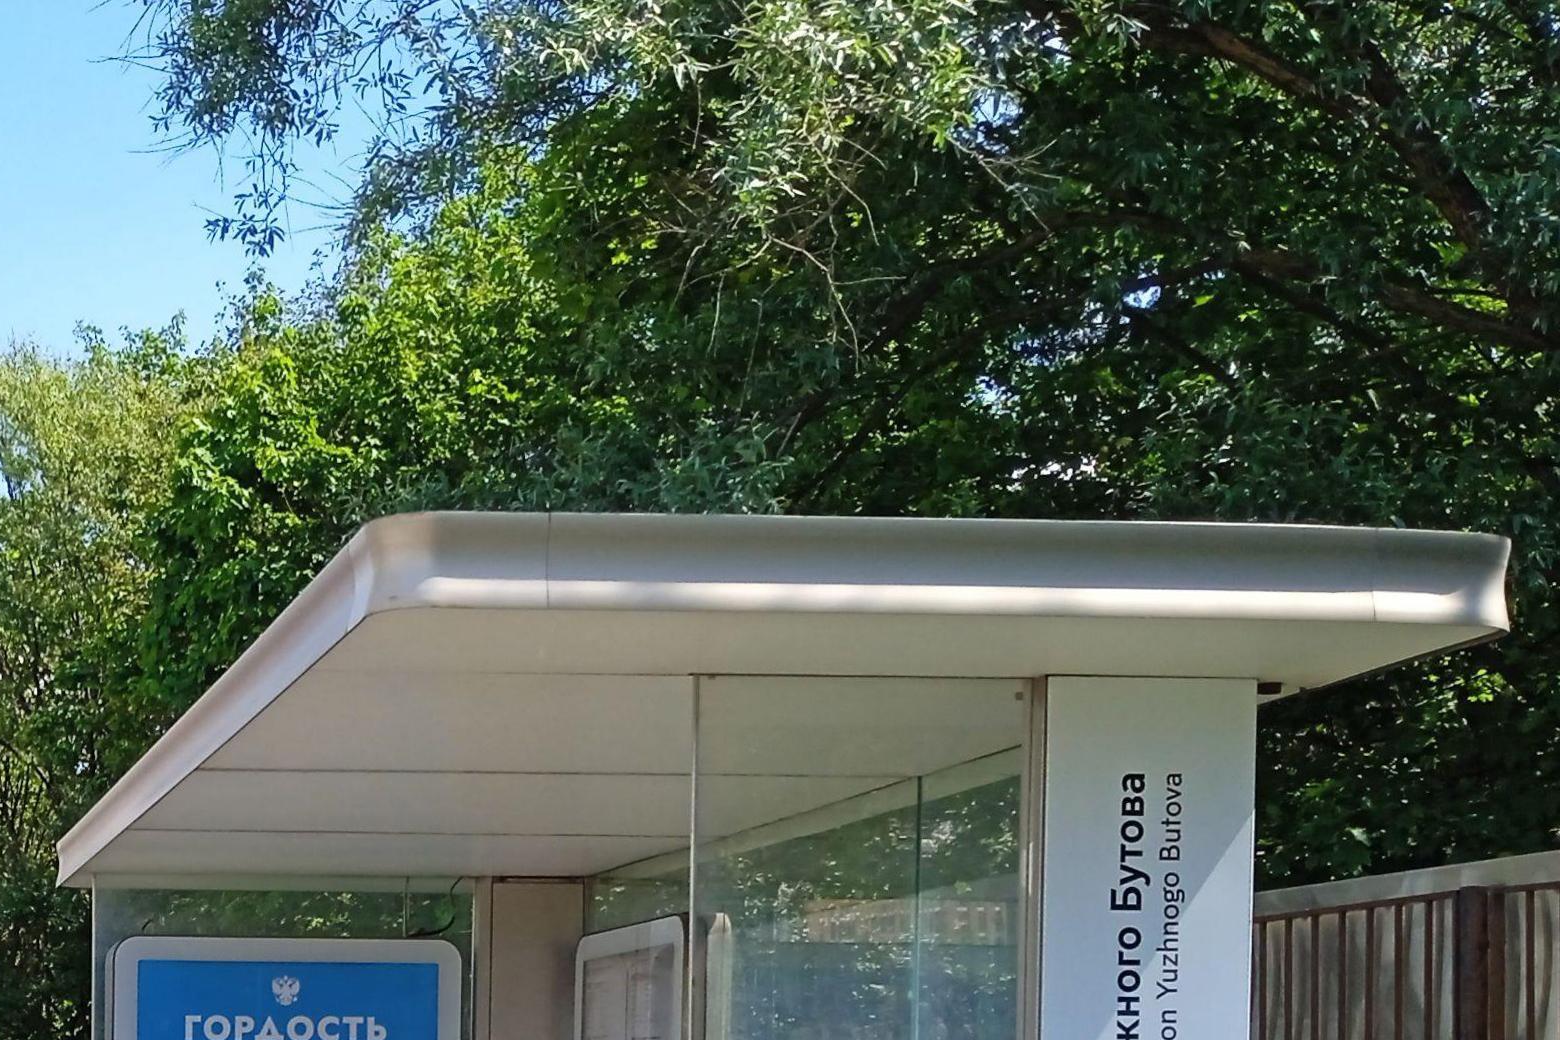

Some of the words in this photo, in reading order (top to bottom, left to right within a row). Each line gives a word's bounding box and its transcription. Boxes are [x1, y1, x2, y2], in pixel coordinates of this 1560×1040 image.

[1109, 772, 1151, 912] Бутова
[1158, 772, 1183, 862] Butova
[1155, 870, 1186, 1000] Yuzhnogo
